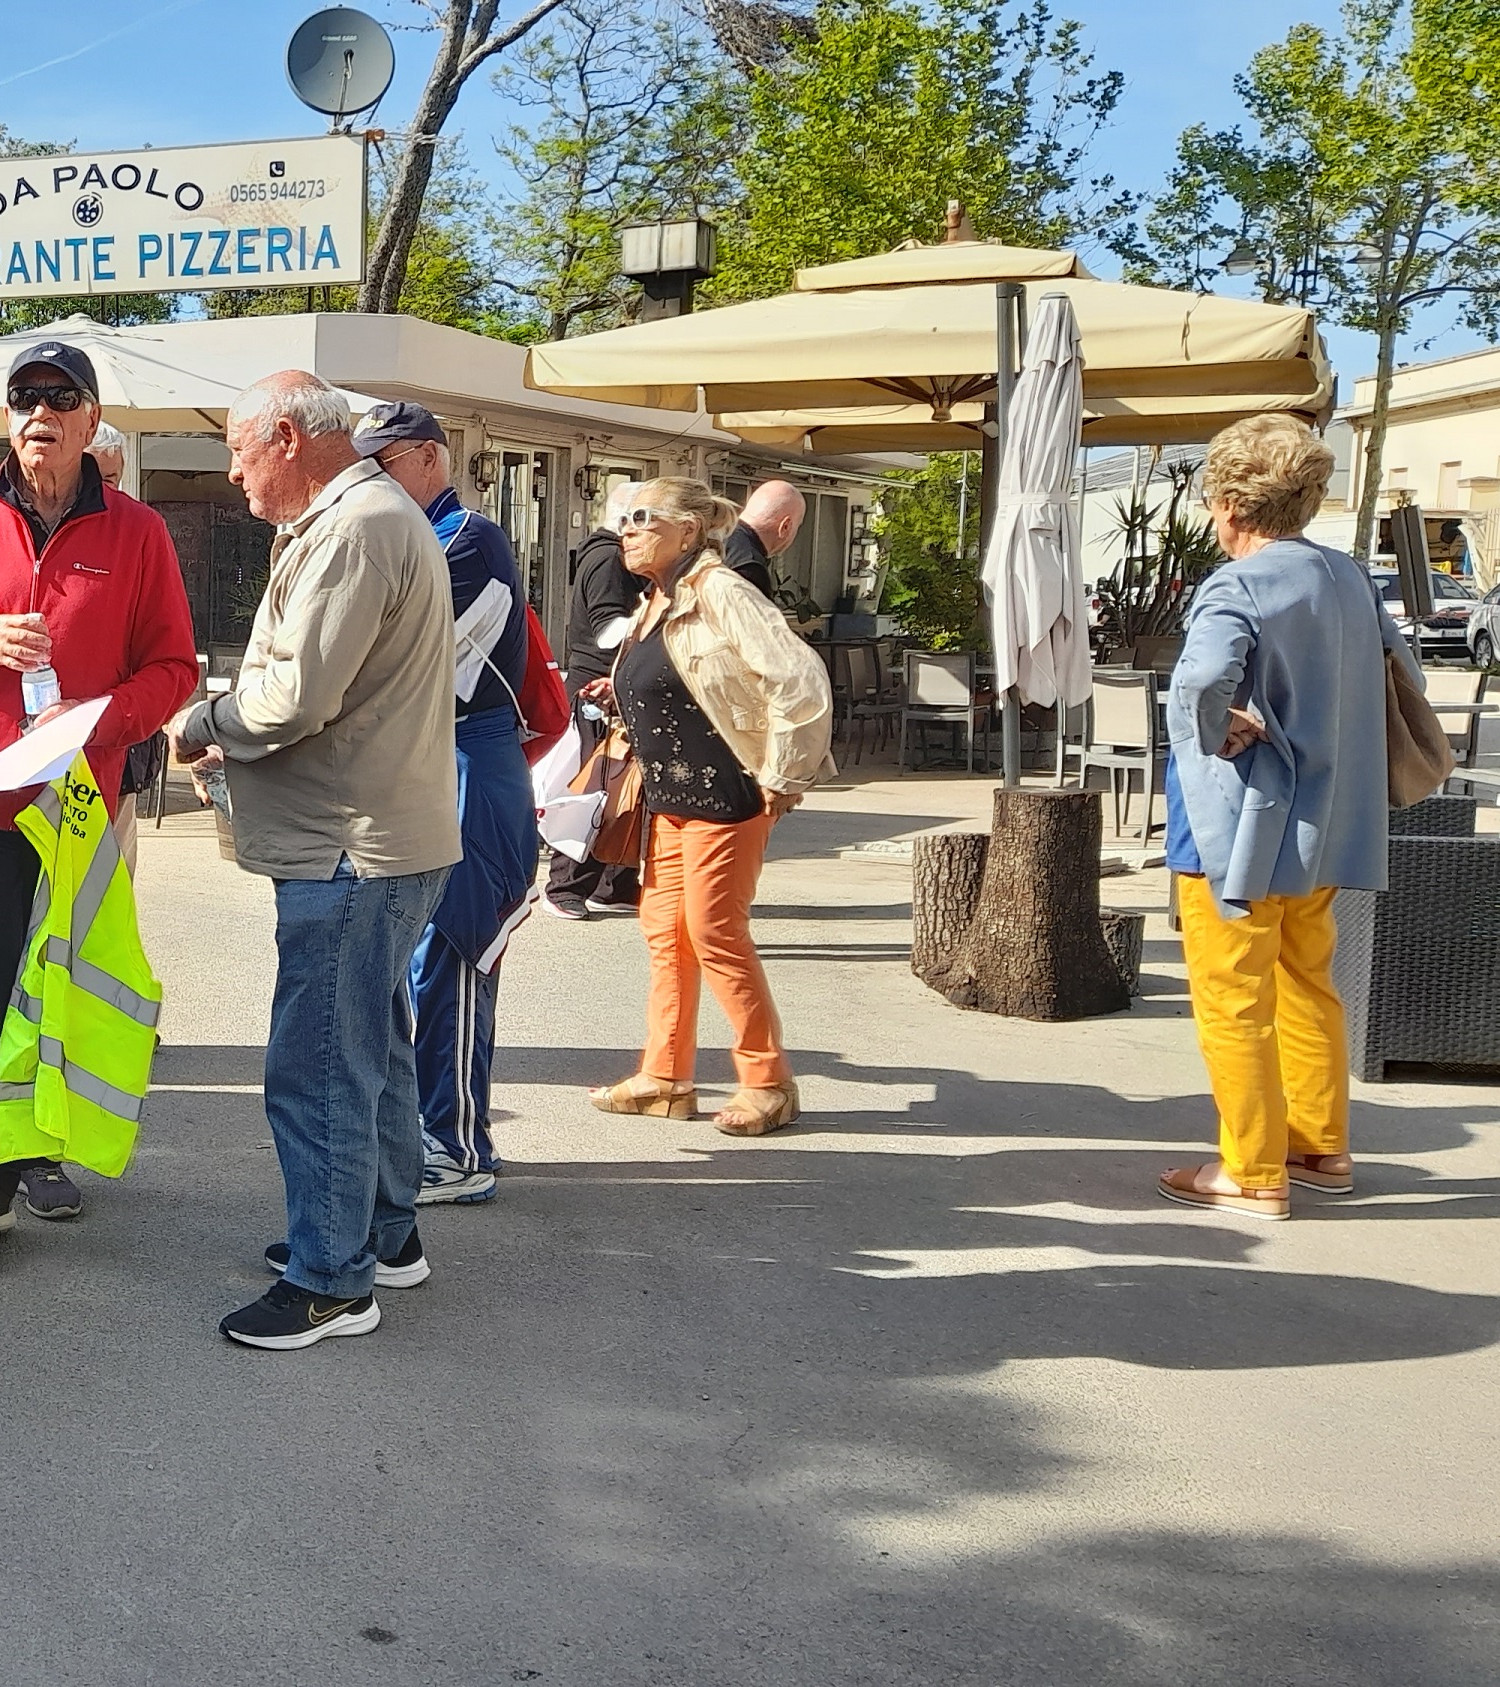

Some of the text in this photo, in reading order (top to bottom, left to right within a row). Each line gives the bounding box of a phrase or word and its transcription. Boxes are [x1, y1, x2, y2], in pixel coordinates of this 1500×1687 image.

[53, 163, 204, 212] PAOLO
[230, 178, 325, 202] 0565 944273
[138, 224, 341, 279] PIZZERIA
